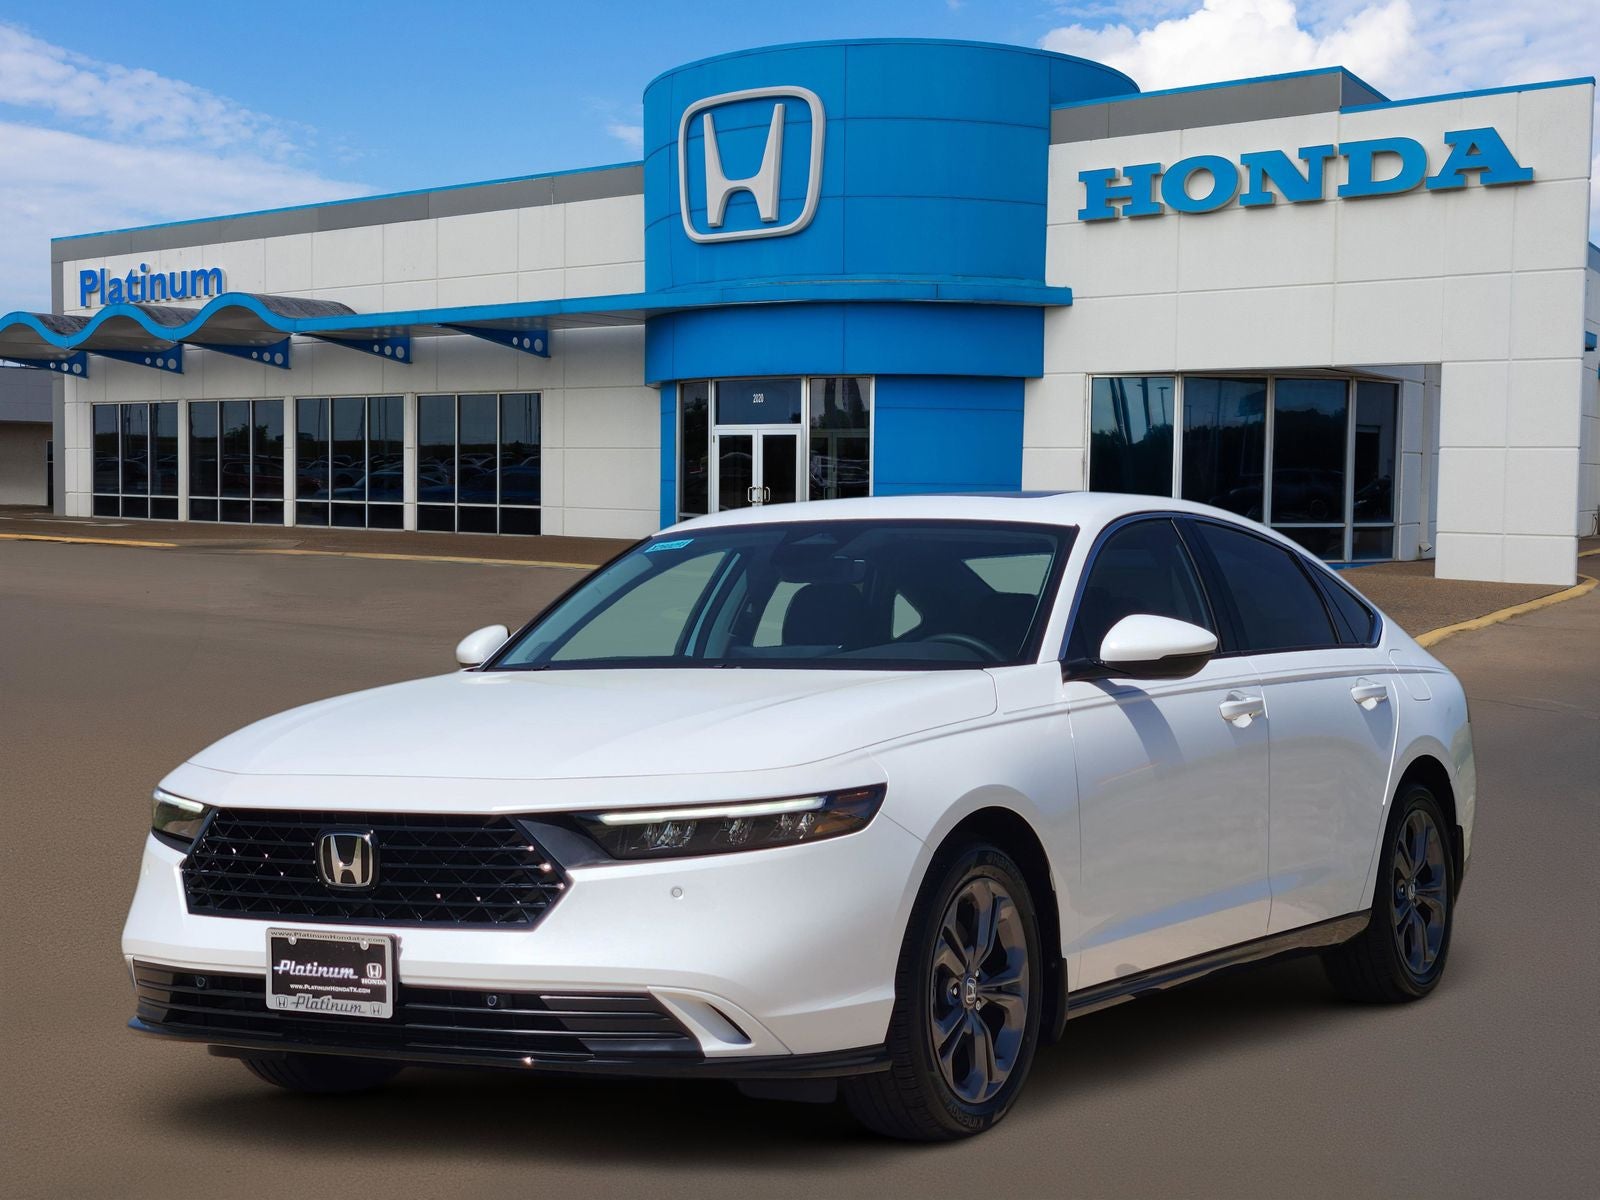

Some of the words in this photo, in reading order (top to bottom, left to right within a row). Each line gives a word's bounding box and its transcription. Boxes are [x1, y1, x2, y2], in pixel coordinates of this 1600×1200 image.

[1078, 126, 1534, 223] HONDA
[79, 263, 224, 307] Platinum
[273, 960, 358, 979] Platinum
[361, 978, 387, 986] HONDA
[291, 995, 366, 1014] Platinum
